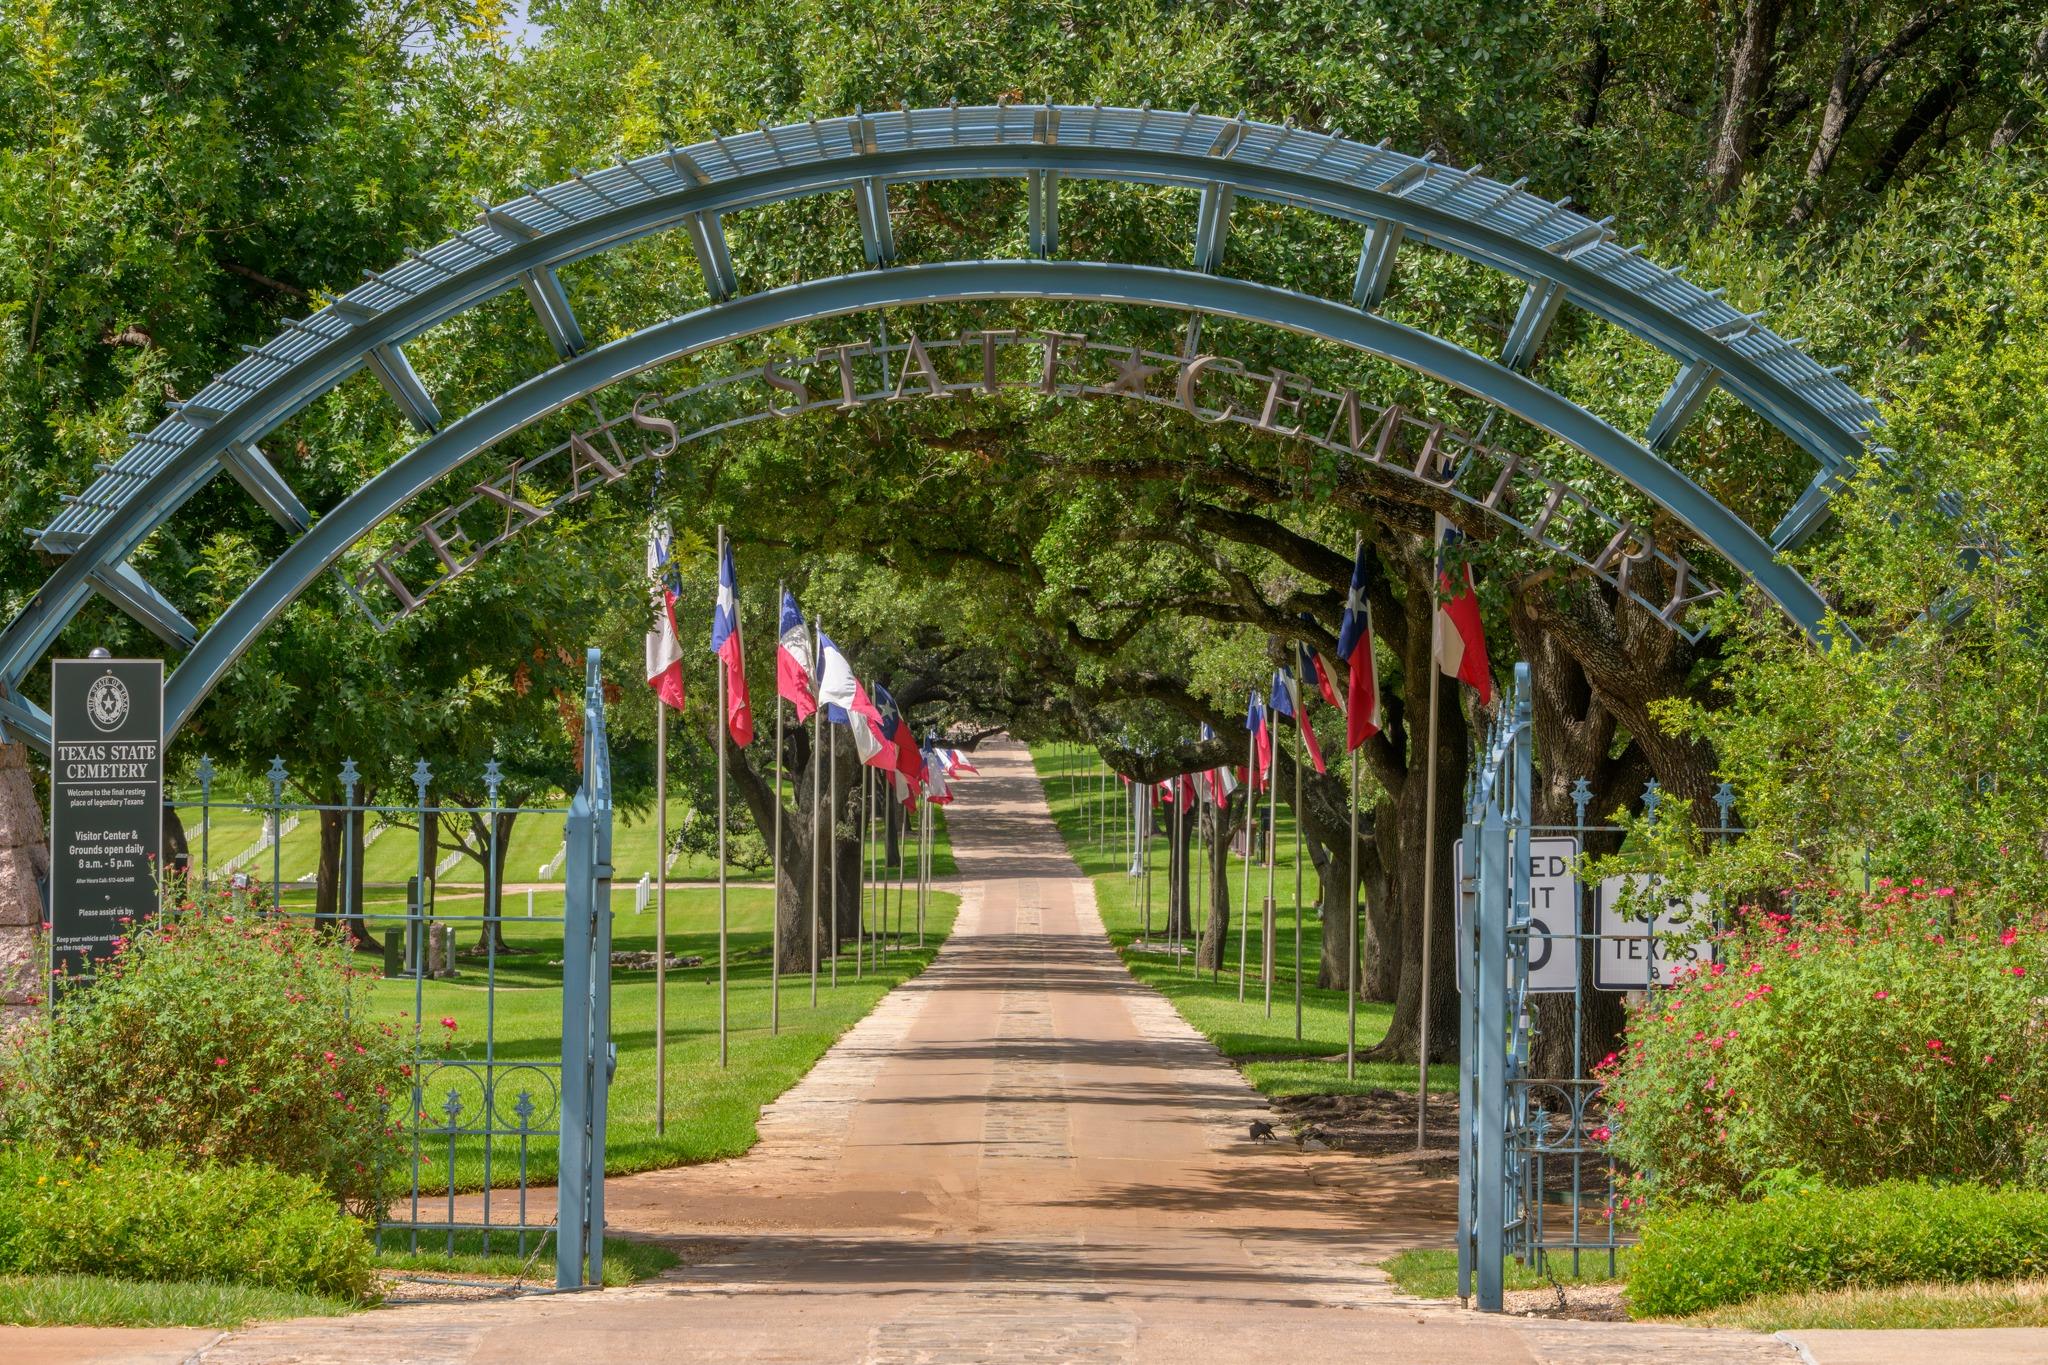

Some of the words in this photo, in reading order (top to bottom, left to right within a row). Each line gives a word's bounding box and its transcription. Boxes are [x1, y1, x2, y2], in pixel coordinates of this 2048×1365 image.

[356, 392, 680, 617] TEXAS
[763, 328, 1087, 418] STATE
[1177, 355, 1724, 631] CEMETERY
[57, 745, 106, 761] TEXAS
[110, 745, 157, 761] STATE
[66, 763, 149, 779] CEMETERY
[67, 788, 94, 797] Welcome
[94, 788, 101, 796] to
[101, 788, 111, 796] the
[111, 788, 125, 796] final
[125, 788, 146, 797] resting
[70, 799, 87, 808] place
[94, 798, 123, 807] legendary
[123, 798, 145, 806] Texans
[75, 831, 102, 841] Visitor
[103, 830, 130, 840] Center
[131, 830, 139, 840] &
[69, 845, 103, 855] Grounds
[104, 846, 124, 856] open
[125, 843, 145, 855] daily
[78, 859, 84, 869] 8
[85, 860, 103, 869] a.m.
[109, 858, 116, 868] 5
[116, 859, 135, 870] p.m.
[78, 908, 99, 917] Please
[99, 907, 116, 916] assist
[116, 908, 124, 916] us
[1613, 938, 1698, 961] TEXS
